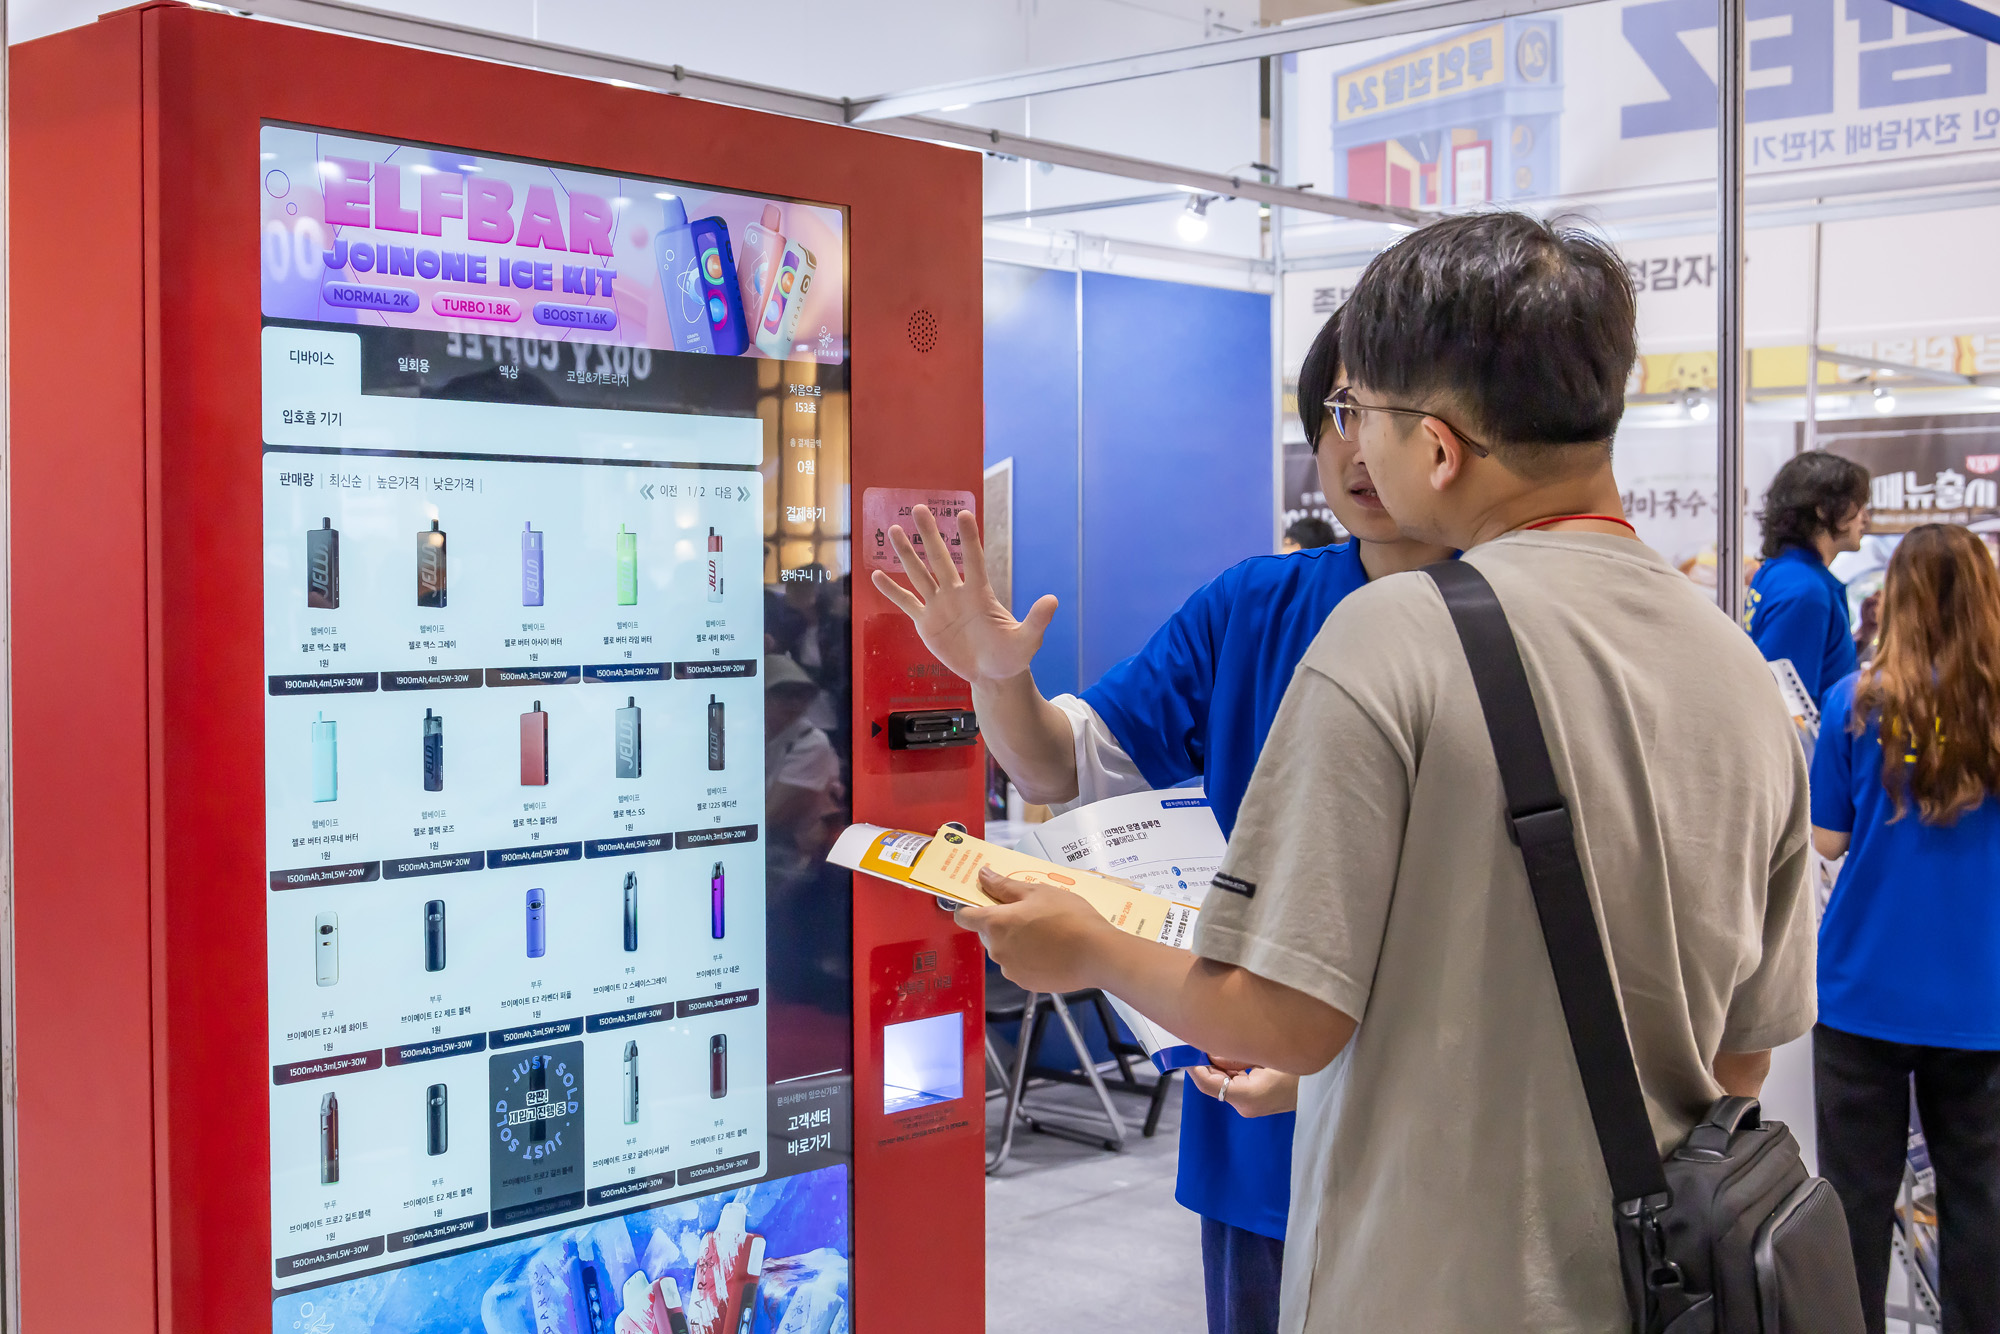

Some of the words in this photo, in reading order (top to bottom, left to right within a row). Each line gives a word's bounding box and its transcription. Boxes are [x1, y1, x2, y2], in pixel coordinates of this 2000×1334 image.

[324, 155, 614, 258] ELFBAR
[322, 238, 487, 284] JOINONE
[499, 256, 553, 292] ICE
[562, 264, 618, 298] KIT
[333, 288, 391, 305] NORMAL
[393, 294, 410, 308] 2K
[442, 298, 485, 314] TURBO
[488, 303, 511, 317] 1.8K
[543, 308, 583, 324] BOOST
[586, 312, 608, 325] 1.6K
[289, 350, 335, 366] 디바이스
[398, 357, 430, 374] 일회용
[499, 364, 519, 380] 액상
[567, 370, 629, 387] 코일&카트리지
[790, 384, 821, 397] 처음으로
[795, 402, 816, 414] 153초
[282, 410, 316, 426] 입호흡
[320, 410, 342, 426] 기기
[798, 438, 822, 449] 결제금액
[797, 460, 814, 475] 0원
[280, 472, 314, 488] 판매량
[329, 473, 362, 489] 최신순
[377, 475, 419, 491] 높은가격
[433, 476, 474, 492] 낮은가격
[660, 485, 677, 498] 이전
[715, 487, 732, 499] 다음
[787, 506, 826, 522] 결제하기
[781, 569, 812, 582] 장바구니
[408, 640, 421, 650] 젤로
[437, 639, 457, 649] 그레이
[517, 638, 530, 647] 버터
[531, 637, 550, 647] 아사이
[551, 637, 563, 646] 버터
[615, 636, 627, 645] 버터
[628, 635, 640, 645] 라임
[640, 635, 652, 644] 버터
[719, 633, 735, 642] 화이트
[301, 643, 315, 653] 젤로
[332, 642, 347, 652] 블랙
[623, 650, 632, 659] 1원
[711, 647, 720, 656] 1원
[319, 658, 329, 668] 1원
[427, 656, 438, 665] 1원
[529, 653, 538, 662] 1원
[713, 815, 721, 824] 1원
[413, 827, 426, 837] 젤로
[428, 826, 441, 835] 블랙
[442, 824, 455, 834] 로즈
[624, 823, 634, 832] 1원
[291, 838, 306, 849] 젤로
[307, 836, 322, 846] 버터
[323, 834, 344, 844] 리무네
[345, 833, 359, 843] 버터
[530, 832, 540, 841] 1원
[429, 841, 439, 851] 1원
[320, 851, 331, 861] 1원
[696, 968, 722, 980] 브이메이트
[593, 983, 621, 995] 브이메이트
[629, 976, 668, 989] 스페이스그레이
[714, 981, 722, 990] 1원
[501, 996, 531, 1009] 브이메이트
[532, 995, 540, 1005] E2
[626, 995, 635, 1004] 1원
[401, 1011, 433, 1024] 브이메이트
[434, 1010, 443, 1019] E2
[458, 1005, 471, 1016] 블랙
[532, 1010, 542, 1019] 1원
[287, 1028, 321, 1041] 브이메이트
[322, 1026, 332, 1036] E2
[348, 1021, 369, 1032] 화이트
[431, 1025, 441, 1035] 1원
[323, 1042, 334, 1052] 1원
[512, 1055, 552, 1084] JUST
[555, 1062, 578, 1115] SOLD
[526, 1089, 549, 1106] 완판!
[777, 1091, 806, 1107] 문의사항이
[808, 1085, 841, 1102] 있으신가요?
[509, 1107, 537, 1126] 재입고
[537, 1103, 555, 1120] 진행
[556, 1101, 567, 1117] 중
[788, 1108, 830, 1131] 고객센터
[496, 1100, 520, 1153] SOLD
[737, 1128, 748, 1138] 블랙
[523, 1131, 562, 1161] JUST
[788, 1132, 831, 1156] 바로가기
[715, 1147, 723, 1156] 1원
[593, 1155, 621, 1168] 브이메이트
[627, 1165, 636, 1175] 1원
[403, 1195, 435, 1209] 브이메이트
[436, 1194, 445, 1204] E2
[460, 1187, 473, 1198] 블랙
[433, 1209, 443, 1218] 1원
[289, 1219, 323, 1233] 브이메이트
[325, 1215, 343, 1227] 프로2
[326, 1232, 336, 1241] 1원
